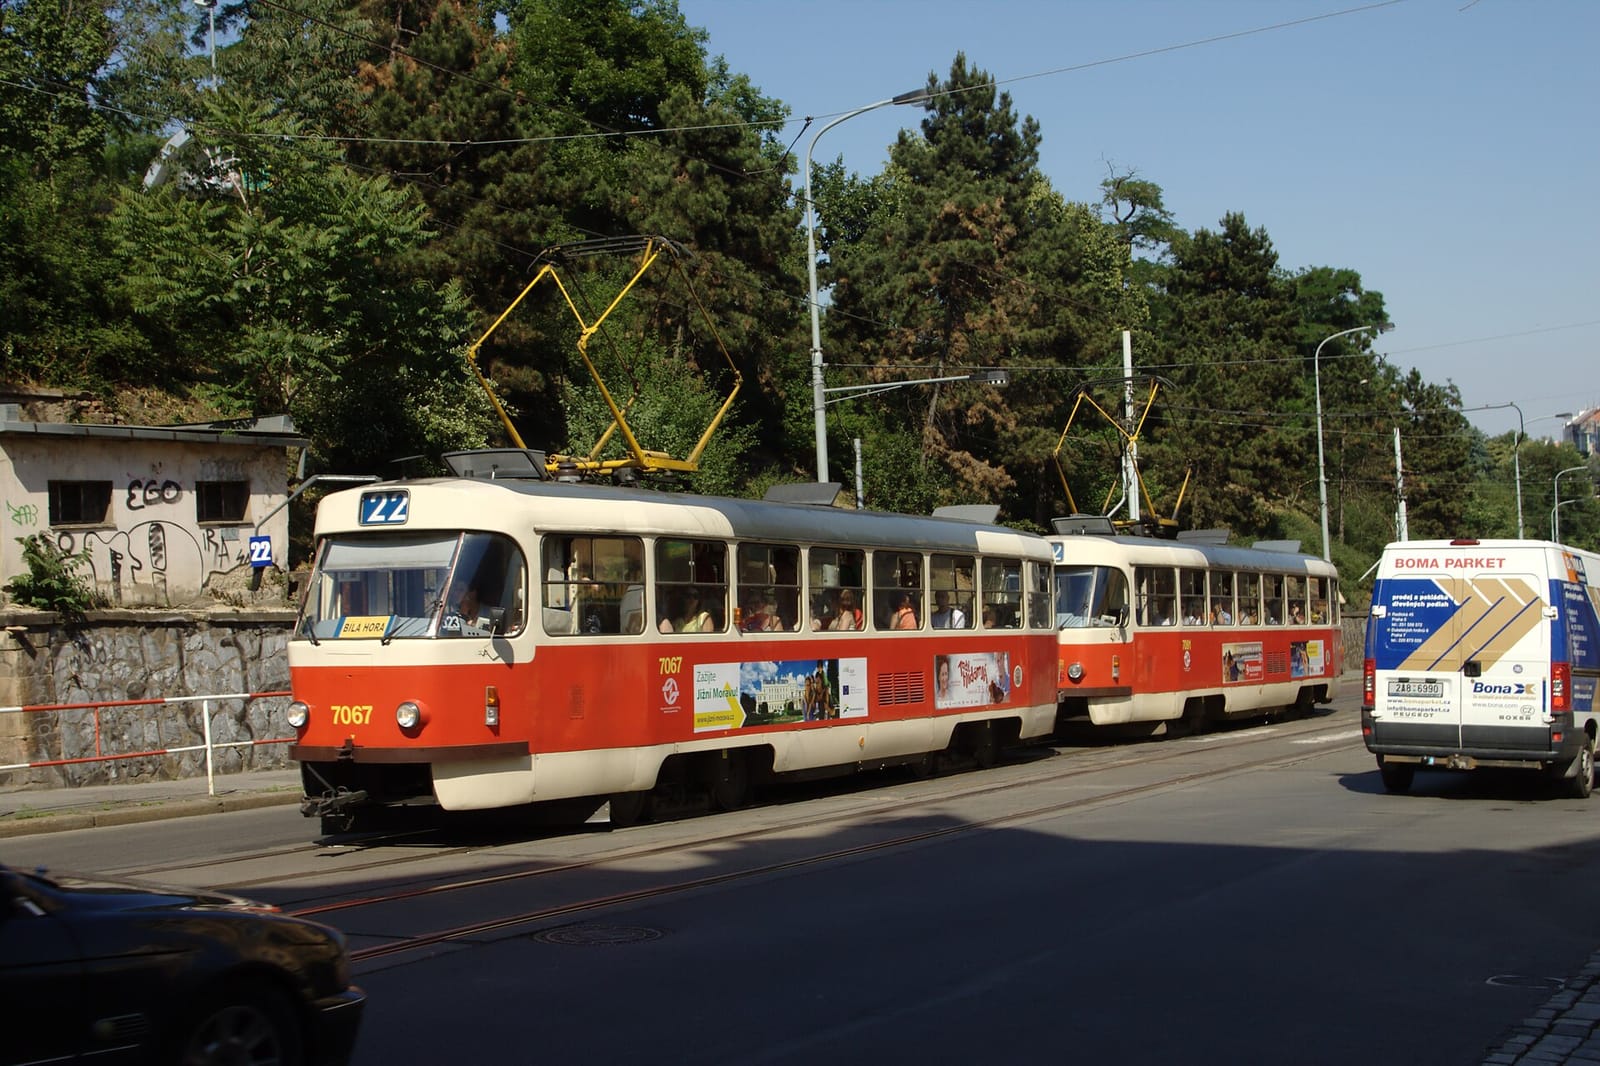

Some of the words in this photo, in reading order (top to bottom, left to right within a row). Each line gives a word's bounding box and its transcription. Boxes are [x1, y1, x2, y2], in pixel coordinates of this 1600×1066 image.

[126, 479, 183, 510] EGO
[367, 494, 407, 522] 22
[251, 542, 271, 561] 22
[1395, 558, 1439, 568] BOMA
[1445, 558, 1506, 568] PARKET
[363, 622, 385, 633] HORA
[659, 656, 682, 675] 7067
[713, 685, 739, 698] Moravu!
[1396, 684, 1411, 692] 2A8
[1417, 684, 1439, 693] 6990
[1472, 682, 1512, 694] Bona
[331, 705, 373, 725] 7067
